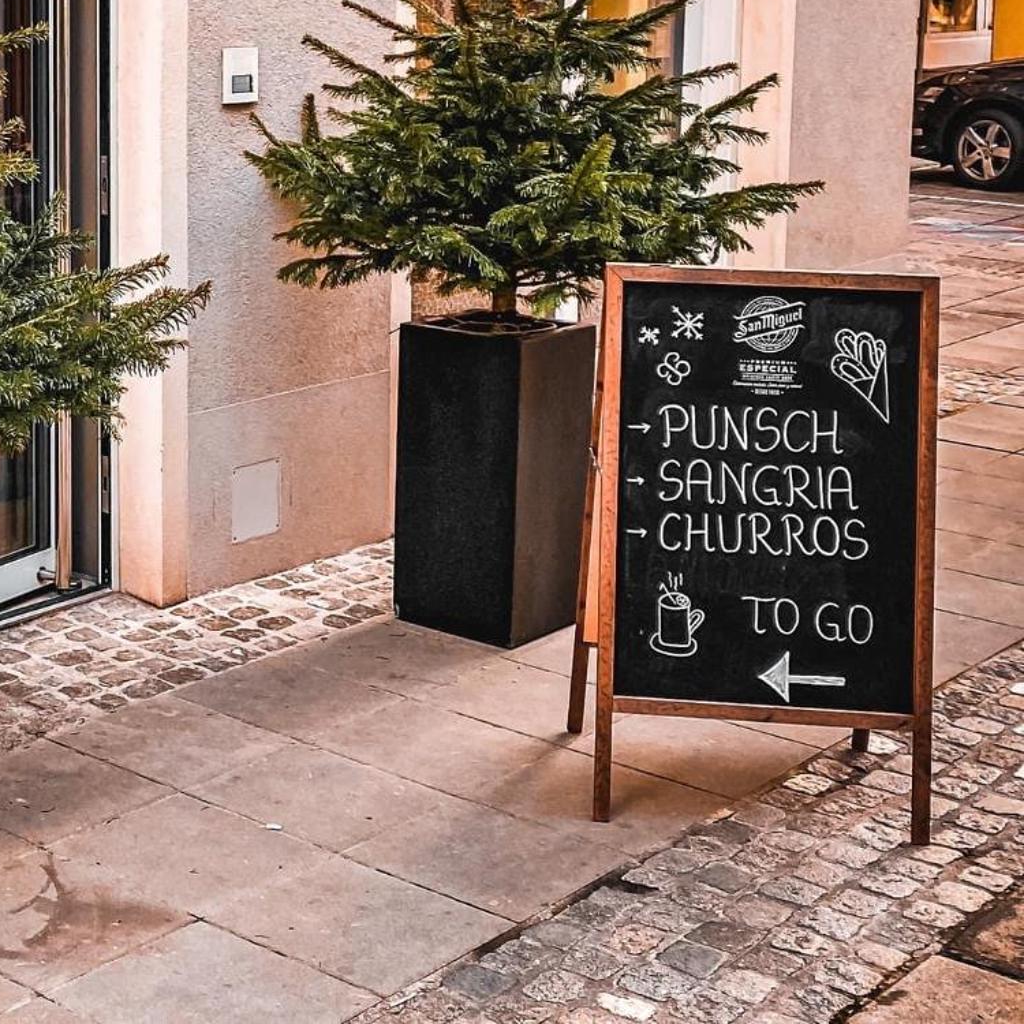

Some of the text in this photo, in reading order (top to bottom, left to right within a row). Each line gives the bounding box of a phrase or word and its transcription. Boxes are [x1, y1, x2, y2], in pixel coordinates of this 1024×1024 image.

[739, 363, 797, 374] ESPECIAL
[658, 404, 844, 454] PUNSCH
[658, 459, 859, 510] SANGRIA
[659, 512, 869, 560] CHURROS
[741, 596, 874, 645] TO GO
